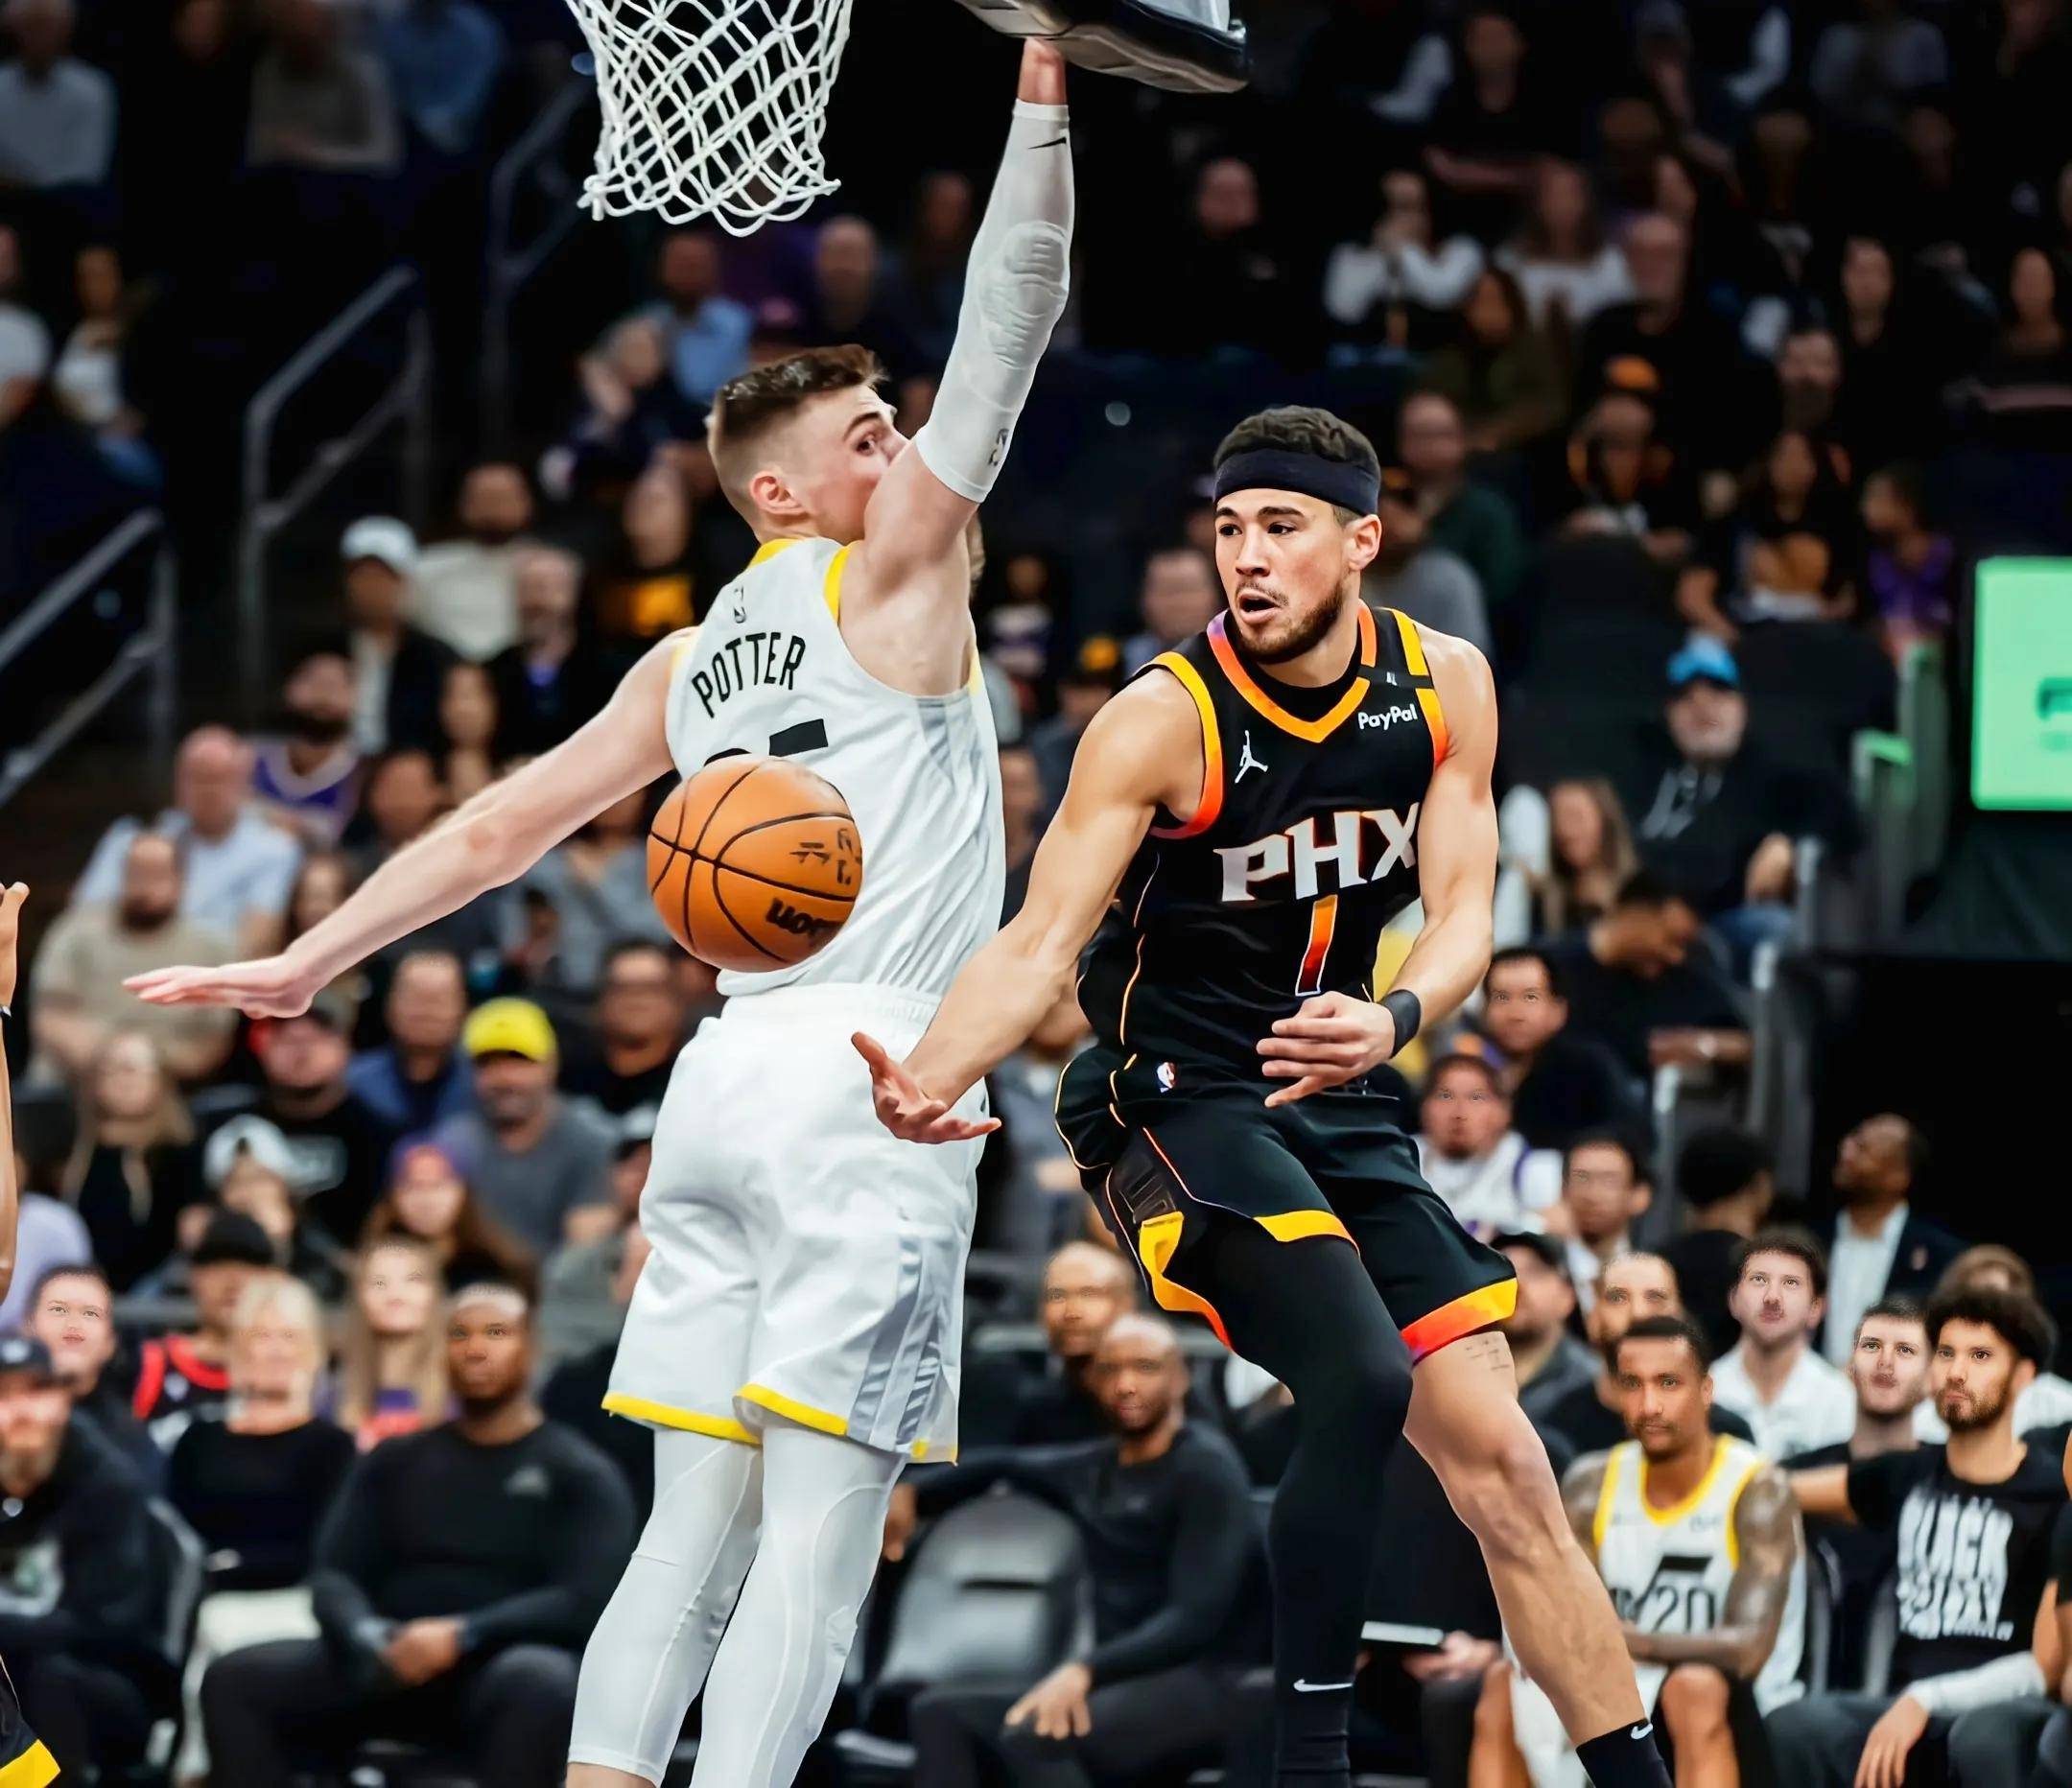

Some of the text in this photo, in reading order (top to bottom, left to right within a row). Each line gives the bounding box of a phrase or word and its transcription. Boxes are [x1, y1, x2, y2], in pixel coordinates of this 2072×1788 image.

[692, 632, 806, 718] POTTER
[1357, 703, 1418, 730] PayPal
[1213, 802, 1420, 902] PHX
[1295, 894, 1338, 997] 1
